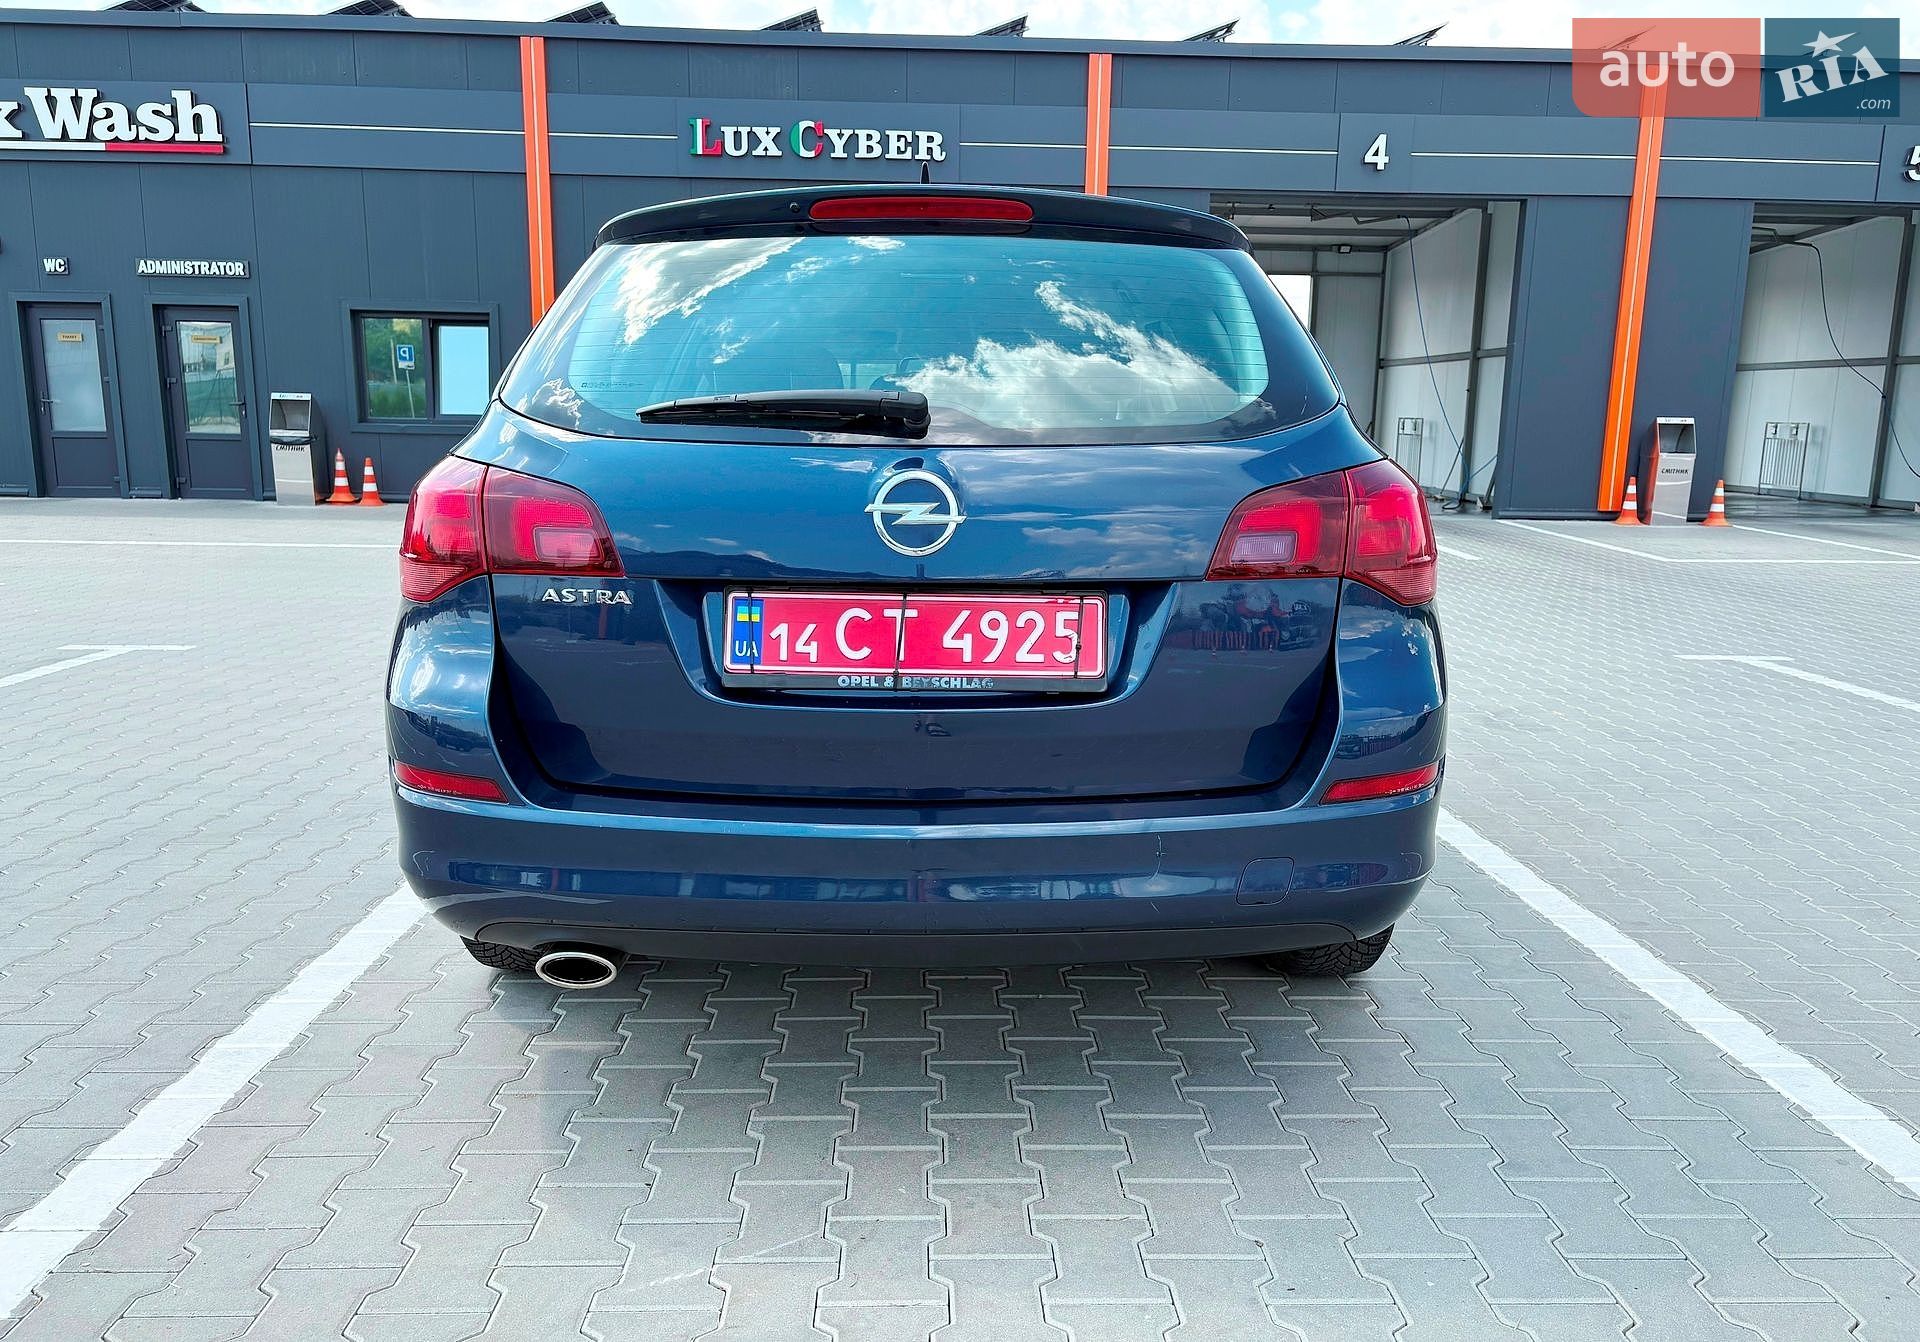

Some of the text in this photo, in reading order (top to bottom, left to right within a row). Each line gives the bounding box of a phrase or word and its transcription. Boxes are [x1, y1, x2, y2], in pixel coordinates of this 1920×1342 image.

[24, 87, 224, 142] Wash
[1364, 133, 1390, 170] 4
[43, 258, 66, 273] WC
[137, 259, 246, 276] ADMINISTRATOR
[541, 587, 633, 605] ASTRA
[769, 623, 818, 663] 14
[942, 609, 1079, 664] 4925
[735, 640, 759, 657] UA
[837, 675, 879, 688] OPEL
